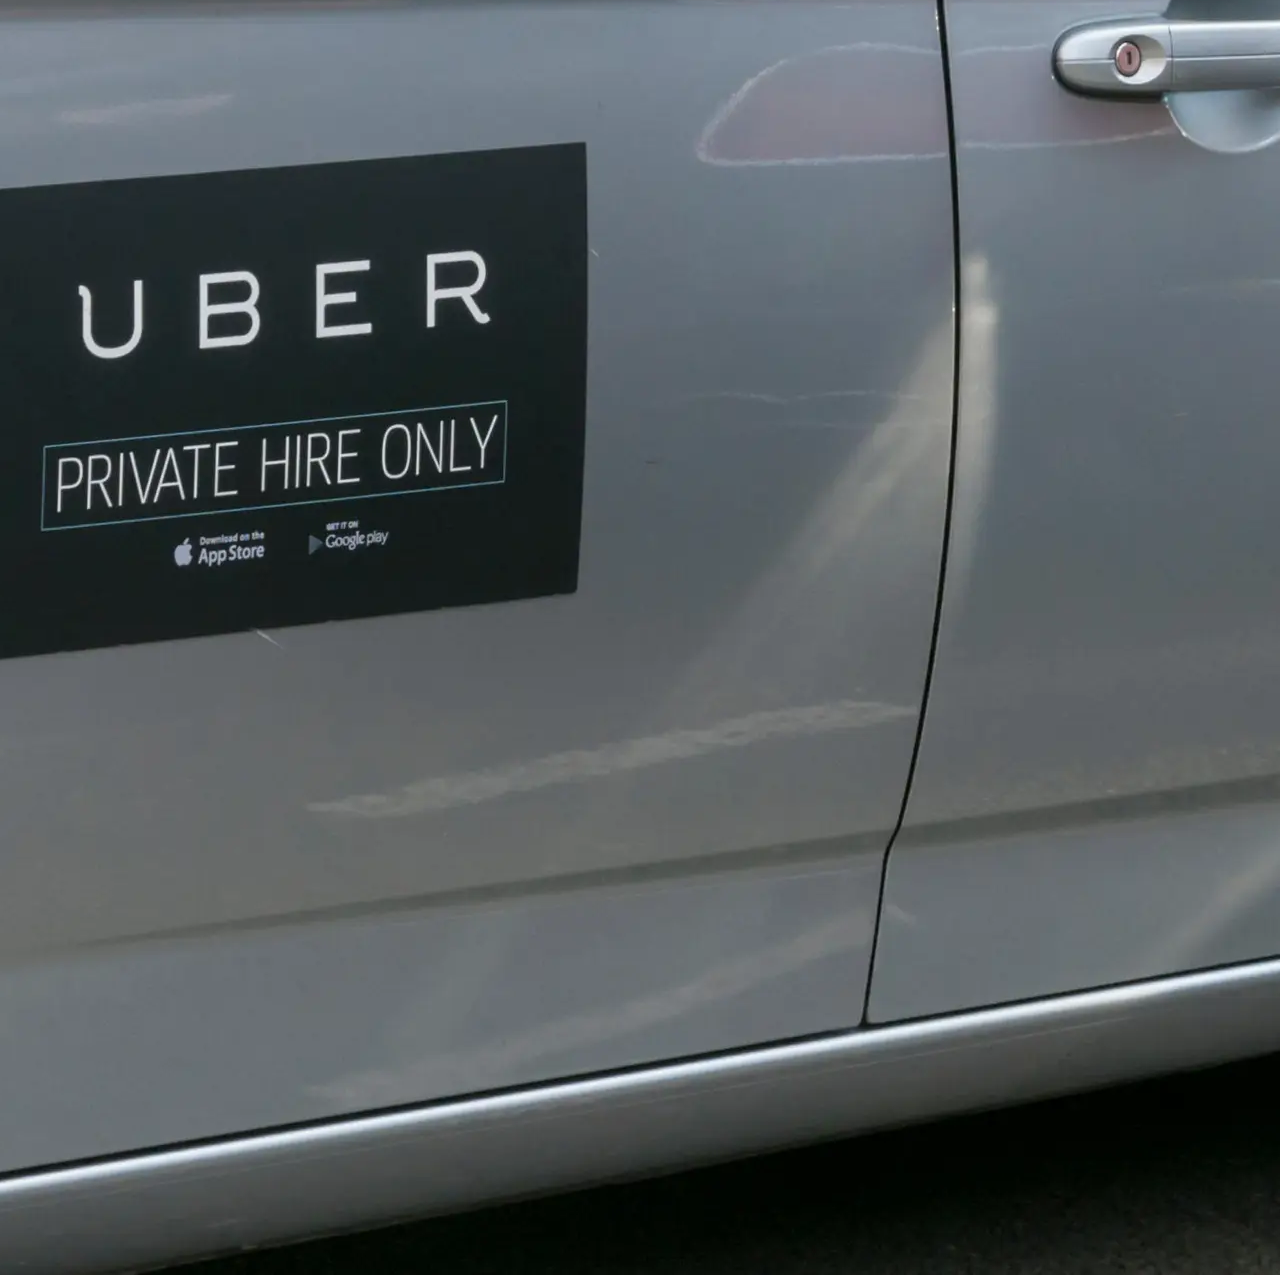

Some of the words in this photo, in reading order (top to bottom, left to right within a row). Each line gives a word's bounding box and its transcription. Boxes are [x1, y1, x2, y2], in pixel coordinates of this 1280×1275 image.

[78, 250, 491, 359] UBER
[56, 440, 239, 513] PRIVATE
[260, 428, 361, 492] HIRE
[381, 414, 498, 479] ONLY
[199, 532, 238, 546] Download
[239, 533, 250, 542] on
[251, 530, 265, 541] the
[325, 530, 366, 551] Google
[366, 530, 389, 547] play
[197, 547, 228, 567] App
[228, 543, 265, 561] Store
